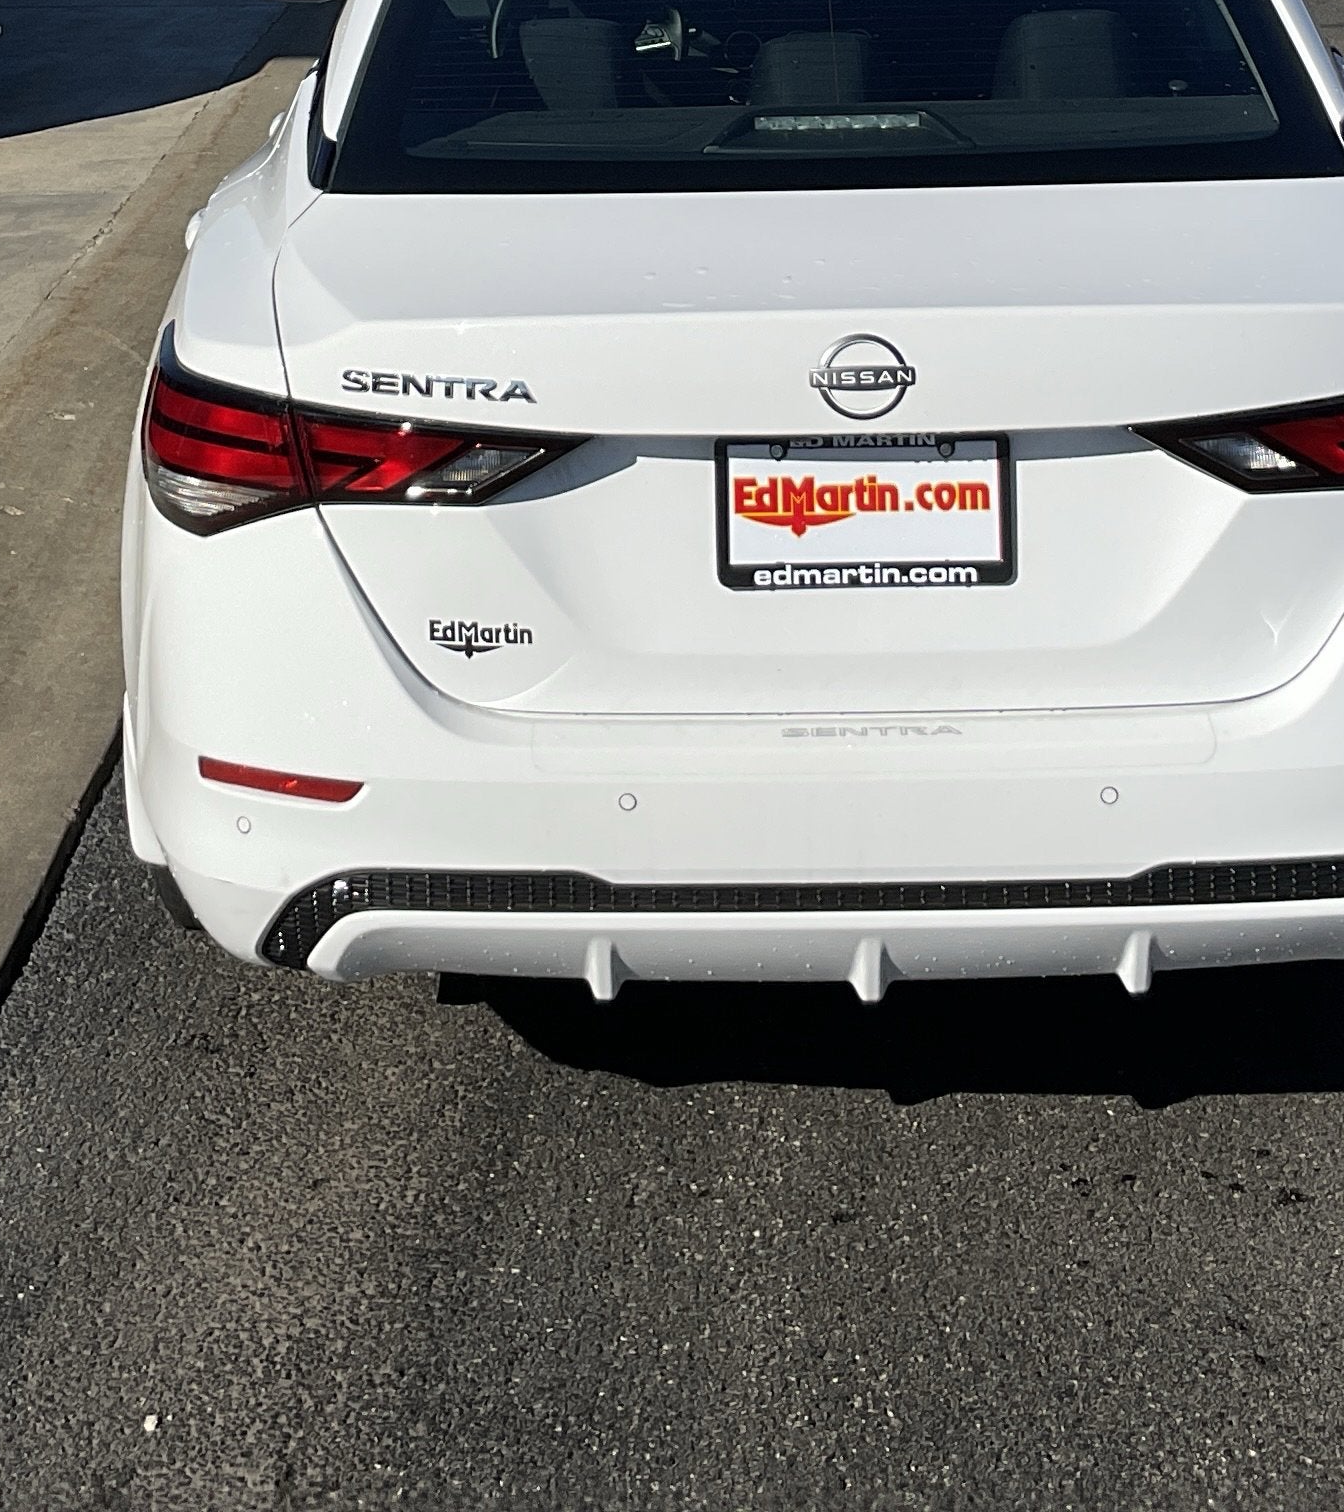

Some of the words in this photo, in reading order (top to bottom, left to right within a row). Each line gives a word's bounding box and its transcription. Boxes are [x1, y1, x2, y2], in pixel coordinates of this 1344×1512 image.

[812, 369, 913, 386] NISSAN
[341, 369, 537, 404] SENTRA
[832, 434, 936, 447] MARTIN
[754, 563, 978, 586] edmartin.com
[781, 725, 963, 738] SENTRA
